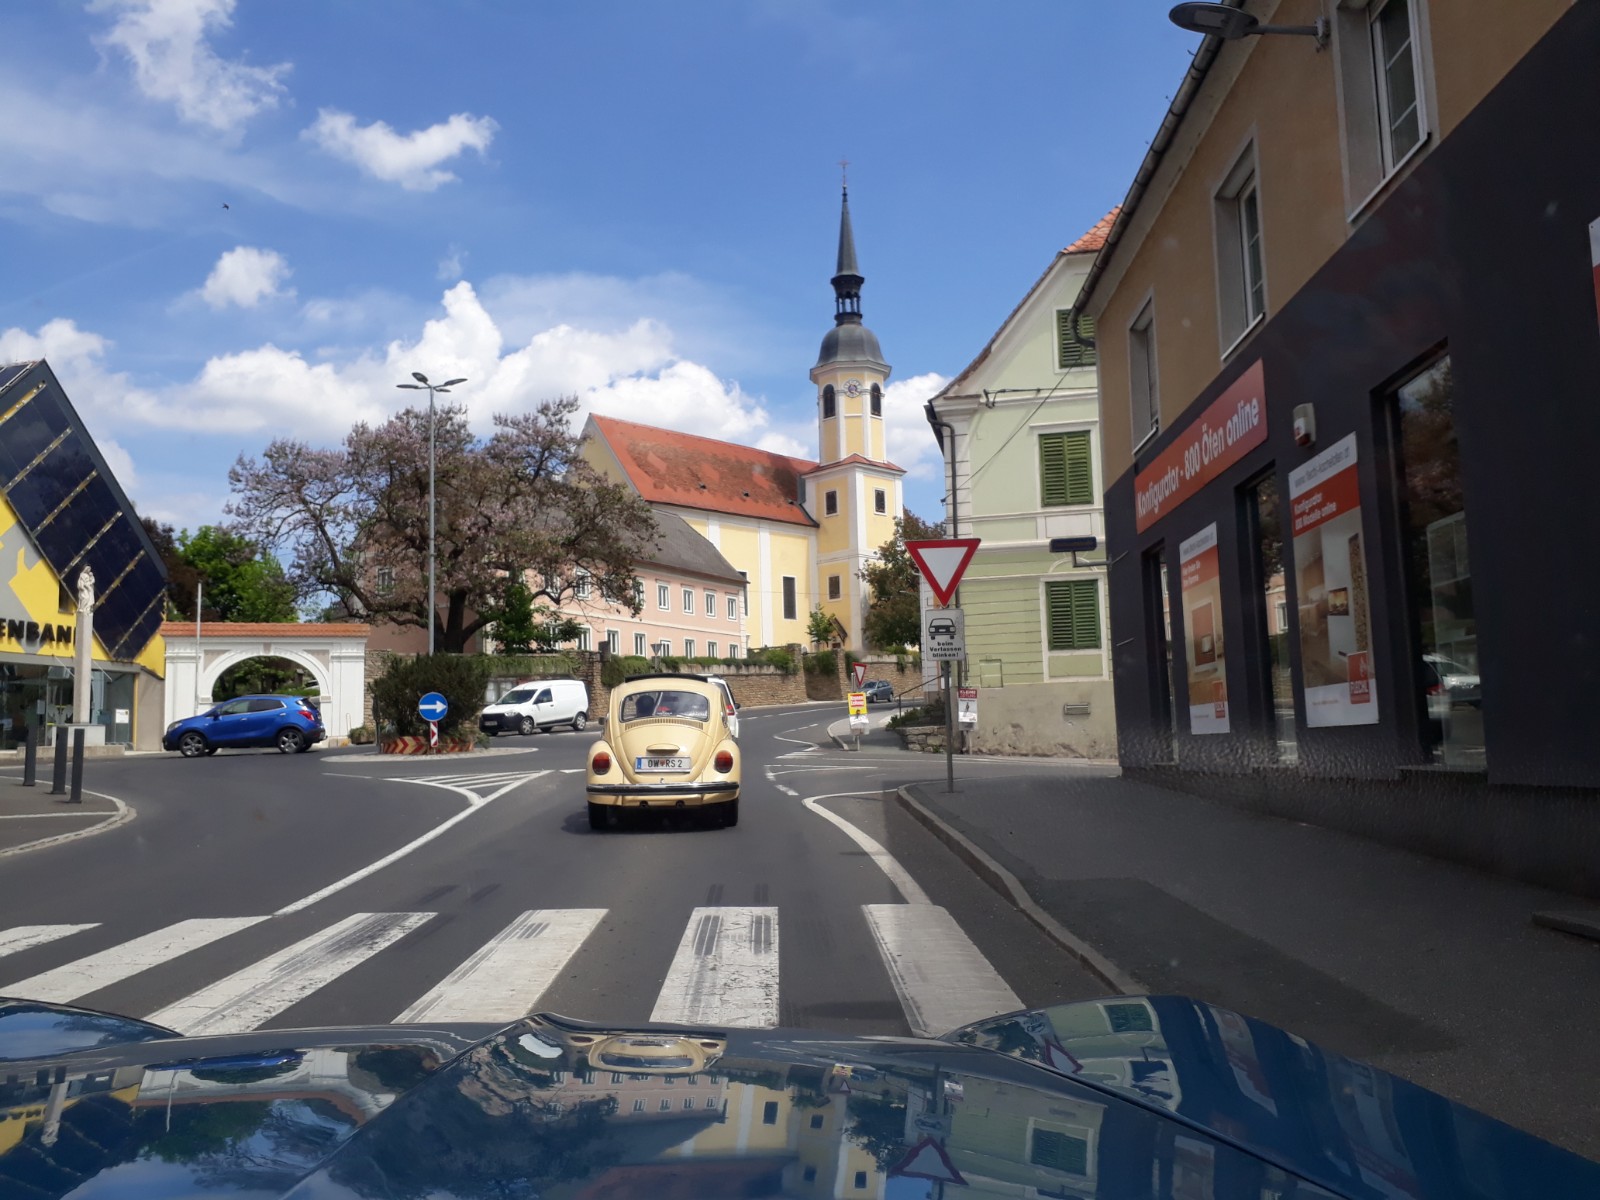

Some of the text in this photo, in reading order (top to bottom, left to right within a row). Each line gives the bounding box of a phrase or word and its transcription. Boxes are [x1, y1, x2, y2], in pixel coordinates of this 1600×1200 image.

[1137, 465, 1179, 519] Konfigurator
[1184, 441, 1200, 480] 800
[1202, 422, 1225, 465] Öfen
[1226, 398, 1259, 446] online
[0, 618, 76, 645] ENBAN
[647, 759, 683, 768] OW RS 2
